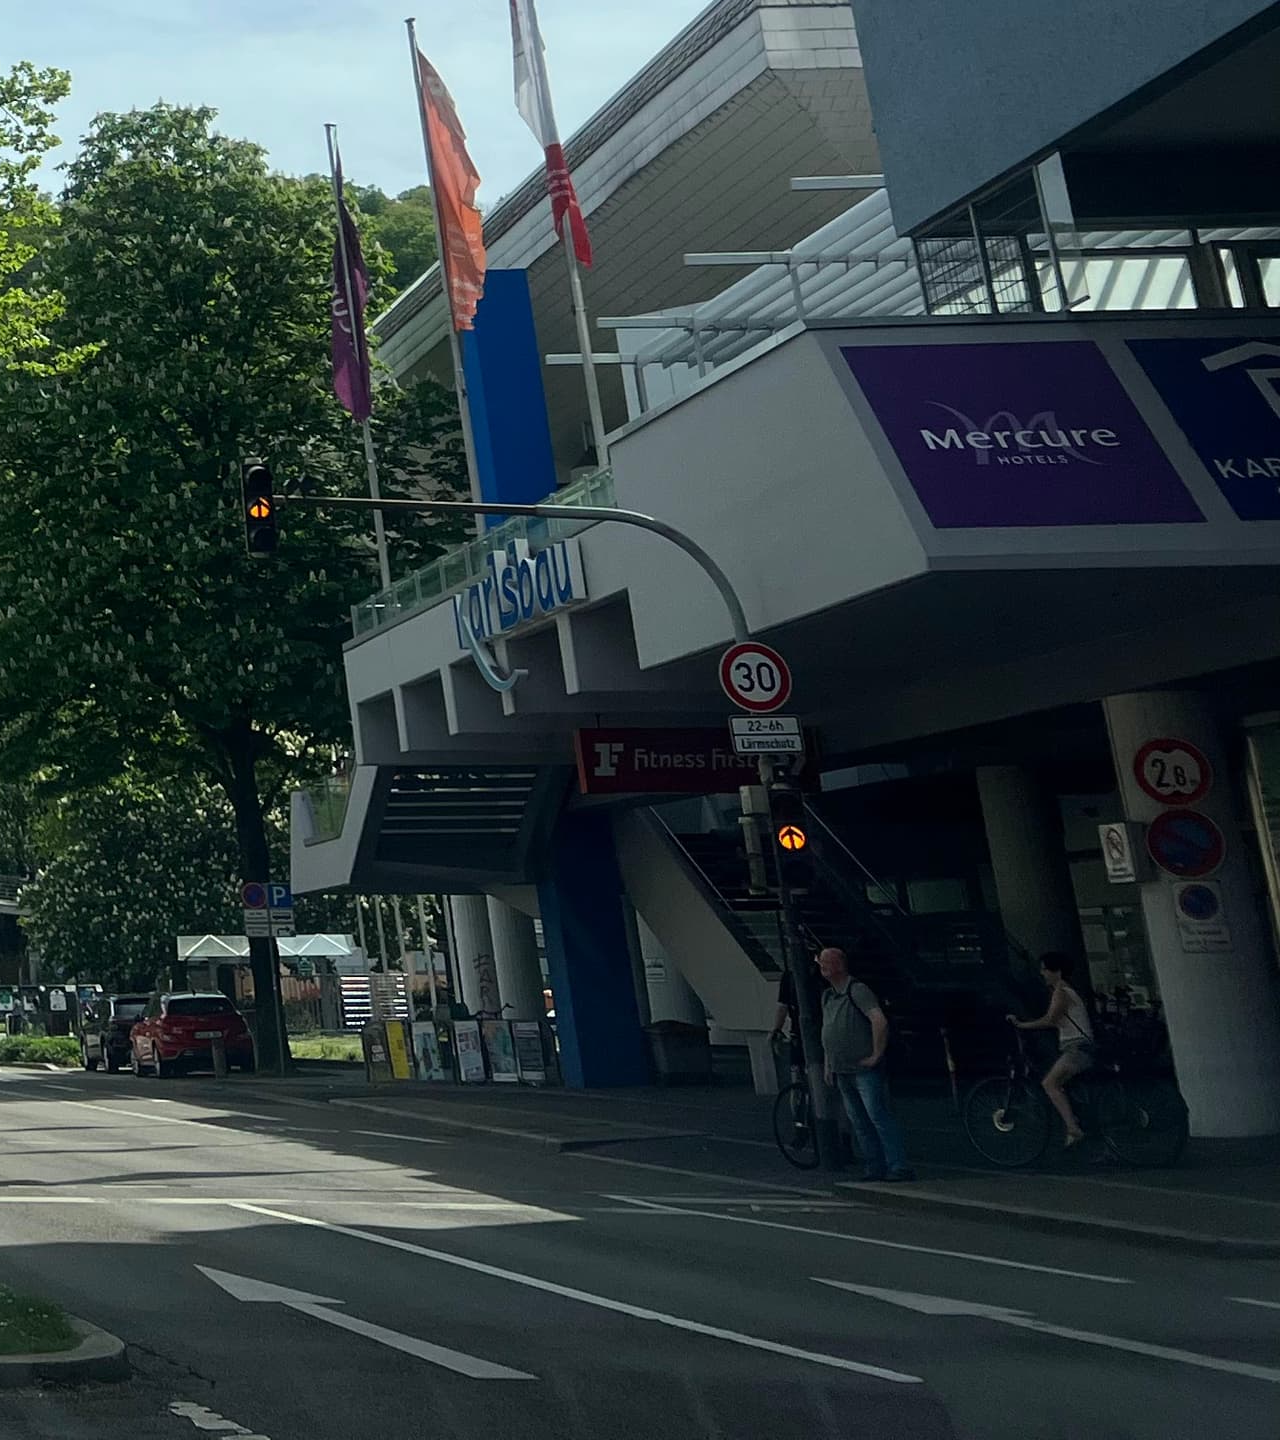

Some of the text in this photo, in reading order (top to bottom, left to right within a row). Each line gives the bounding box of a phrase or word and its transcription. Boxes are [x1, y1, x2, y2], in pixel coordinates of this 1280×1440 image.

[920, 427, 1122, 450] Mercure
[997, 454, 1069, 466] HOTELS
[735, 662, 776, 692] 30
[747, 720, 784, 732] 22-6h
[741, 737, 796, 749] Lärmschutz
[272, 886, 286, 905] P
